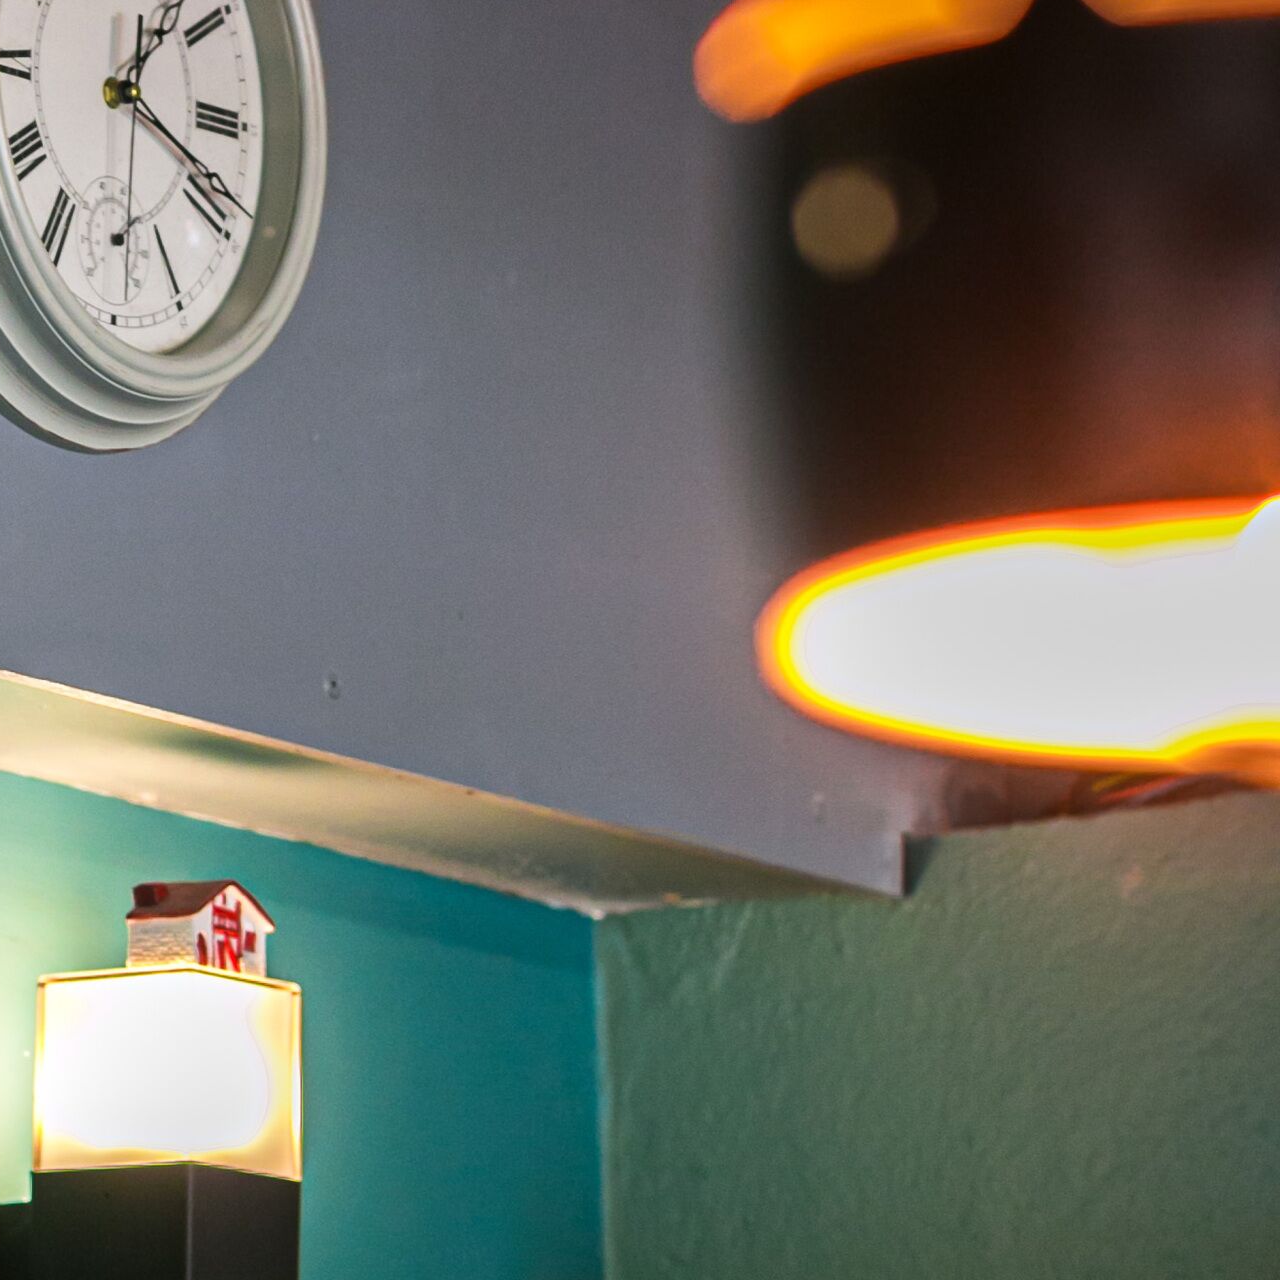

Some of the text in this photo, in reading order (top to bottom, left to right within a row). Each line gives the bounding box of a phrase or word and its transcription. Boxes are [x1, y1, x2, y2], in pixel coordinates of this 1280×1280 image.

[184, 7, 225, 48] II
[195, 100, 239, 140] III
[40, 185, 76, 268] VII
